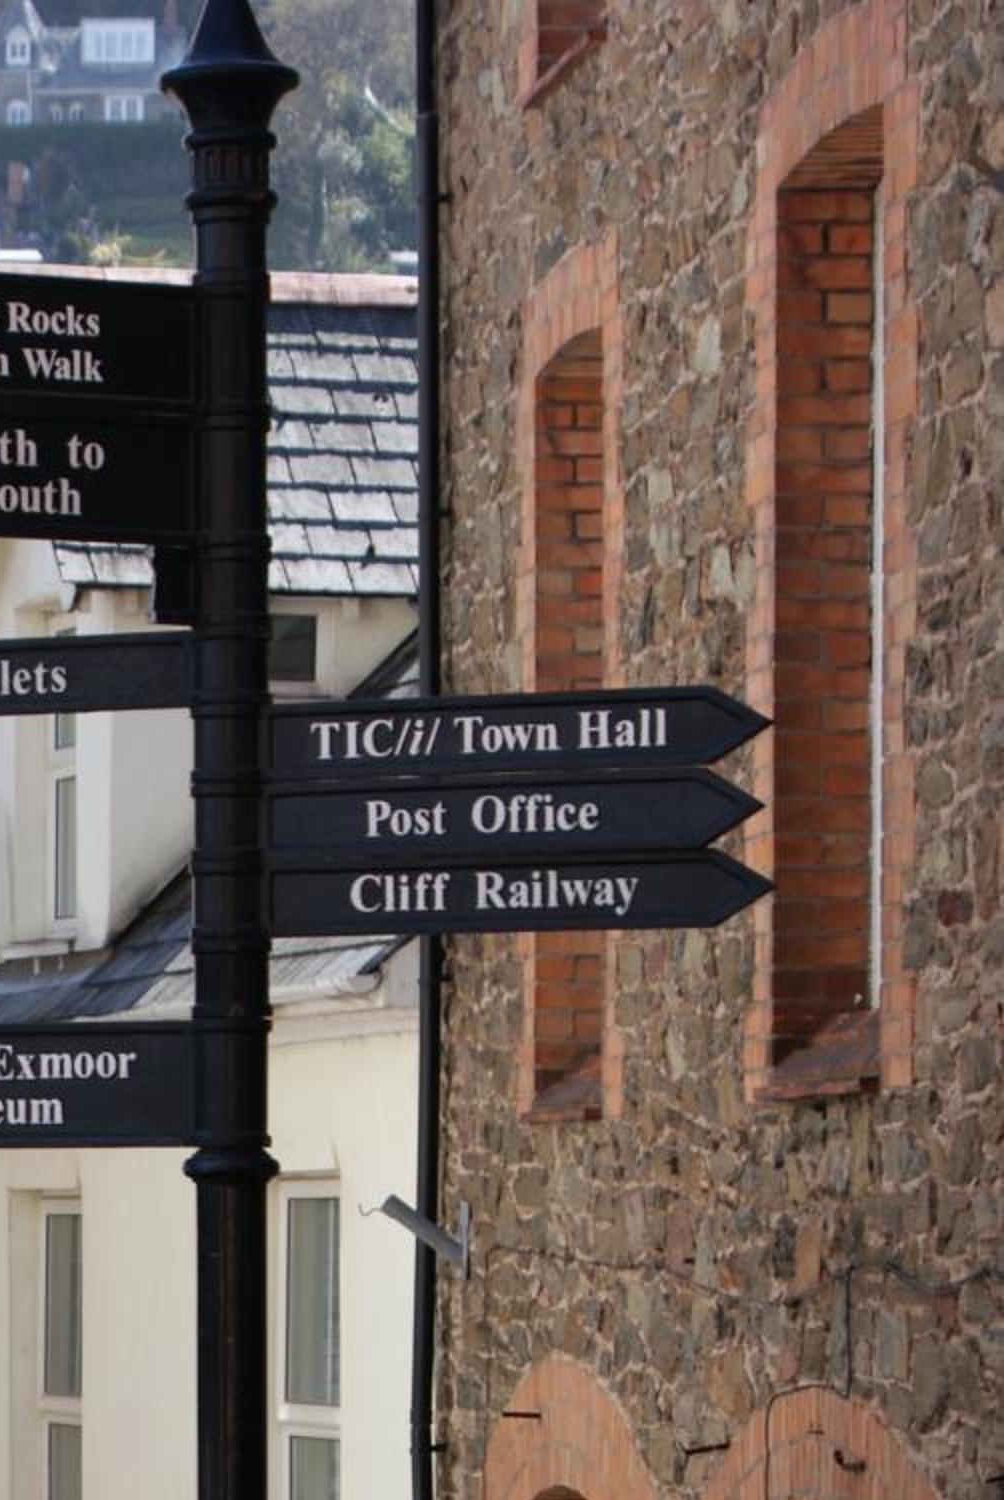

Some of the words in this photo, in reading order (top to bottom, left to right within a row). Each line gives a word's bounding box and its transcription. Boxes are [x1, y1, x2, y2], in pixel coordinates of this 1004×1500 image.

[7, 301, 100, 337] Rocks
[22, 347, 103, 383] Walk
[67, 433, 106, 470] to
[453, 715, 562, 755] Town
[576, 708, 668, 751] Hall
[365, 800, 447, 838] Post
[471, 794, 599, 834] Office
[349, 871, 451, 913] Cliff
[475, 870, 639, 916] Railway
